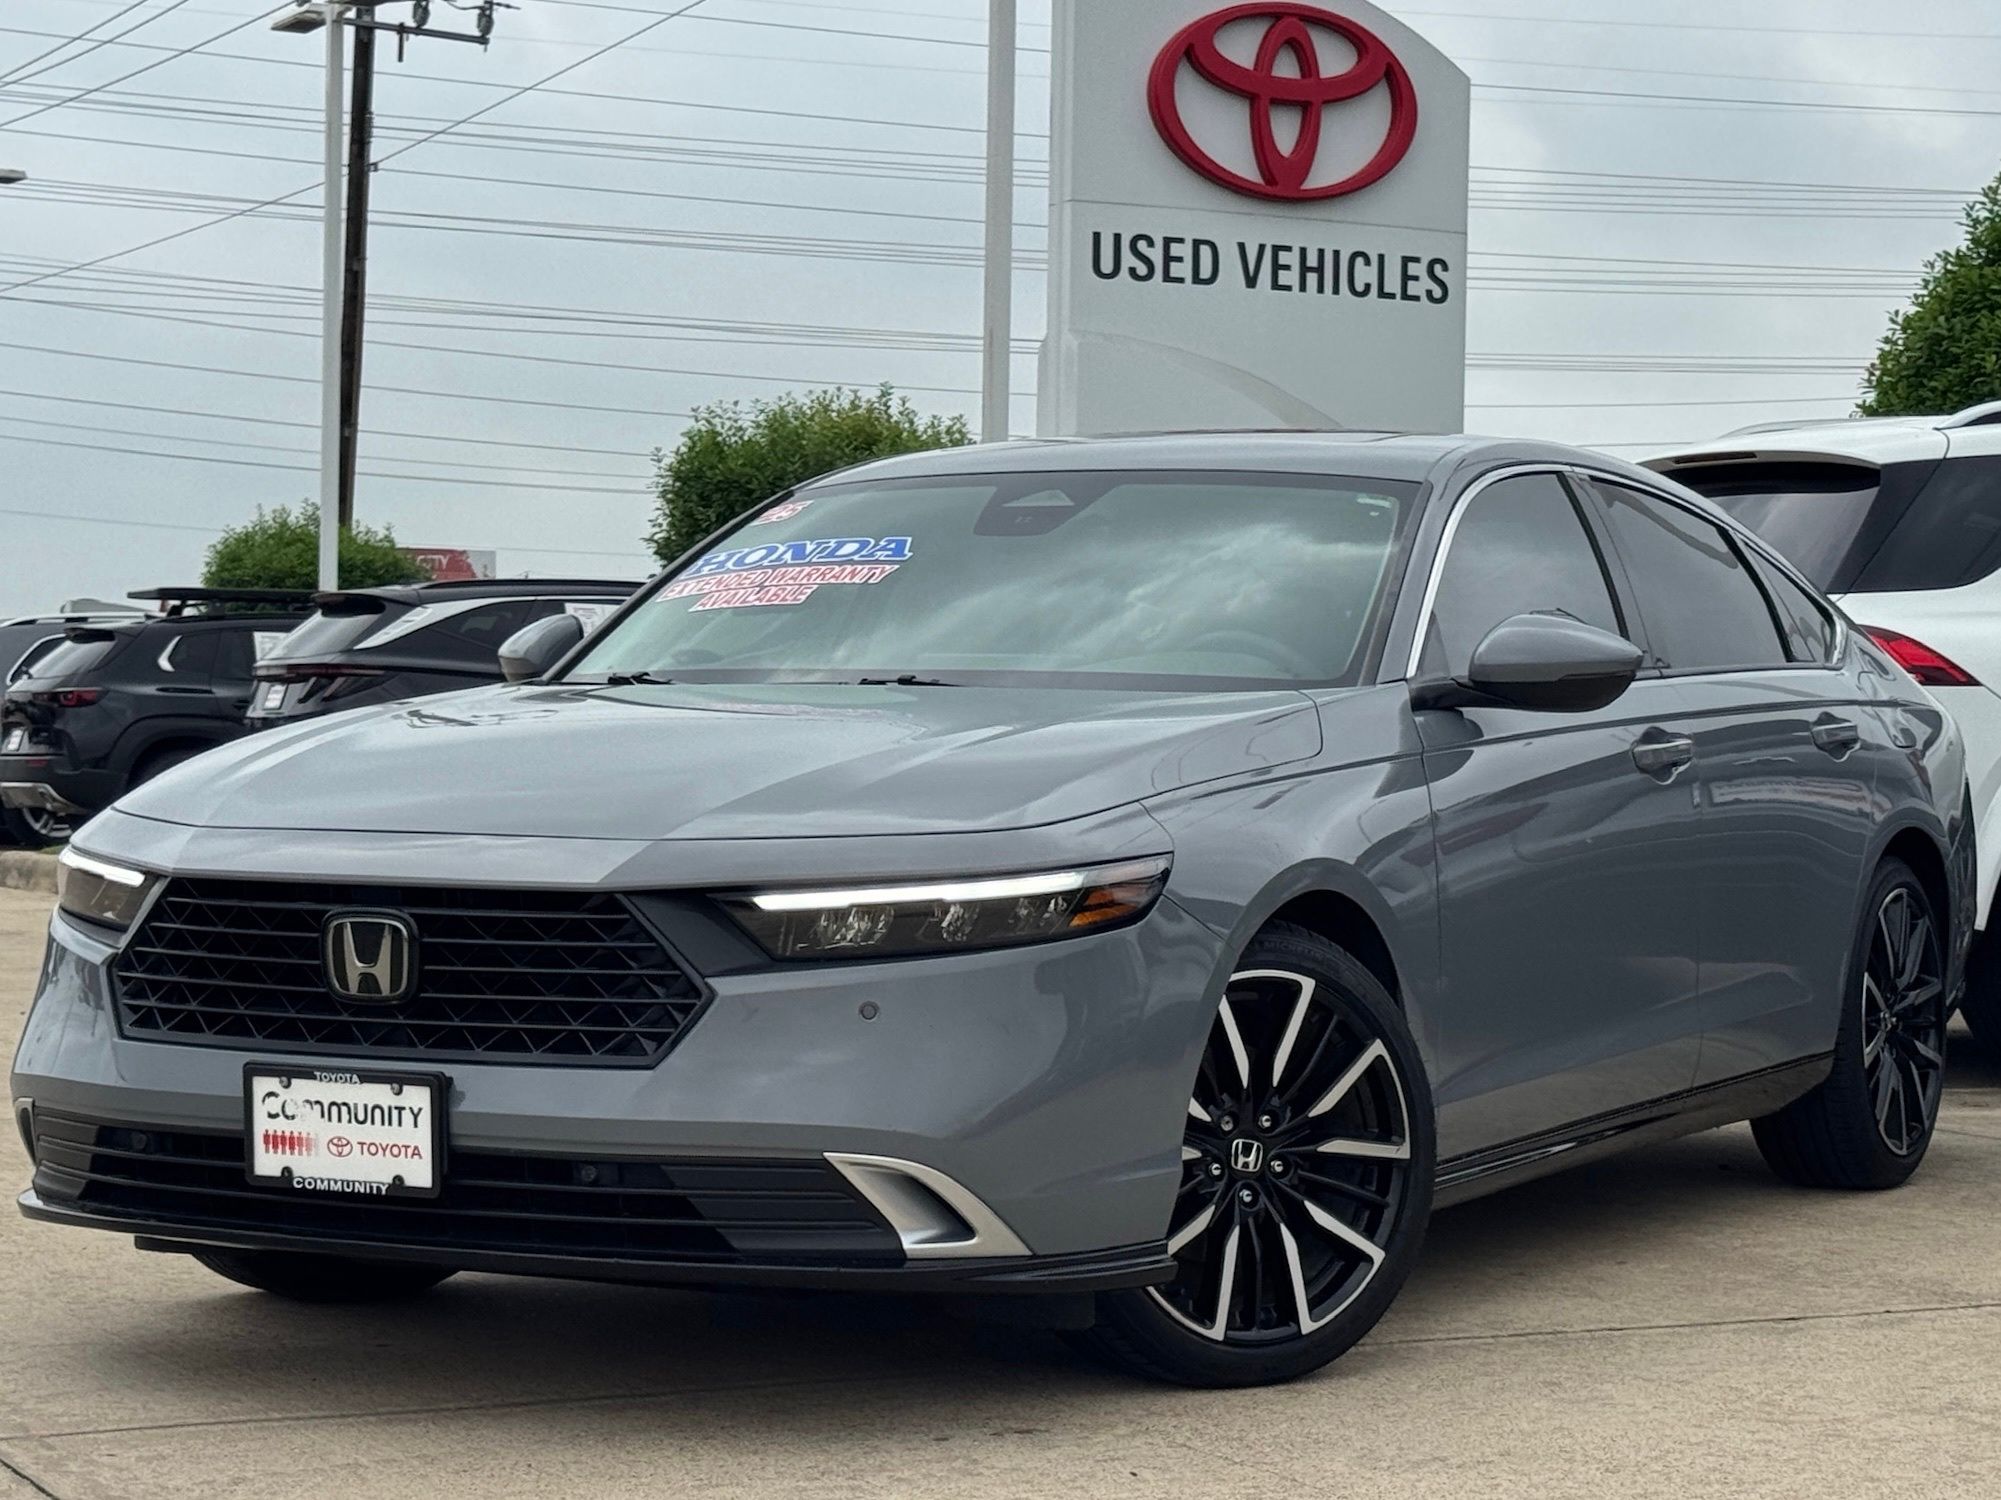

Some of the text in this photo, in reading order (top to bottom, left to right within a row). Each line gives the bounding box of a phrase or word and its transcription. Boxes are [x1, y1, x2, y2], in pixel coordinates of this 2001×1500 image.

[1092, 231, 1449, 304] USED VEHICLES
[690, 537, 910, 574] HONDA
[661, 566, 893, 599] EXTENDED WARRANTY
[698, 586, 813, 609] AVAILABLE
[314, 1071, 360, 1084] TOYOTA
[357, 1142, 423, 1159] TOYOTA
[293, 1177, 389, 1195] COMMUNITY
